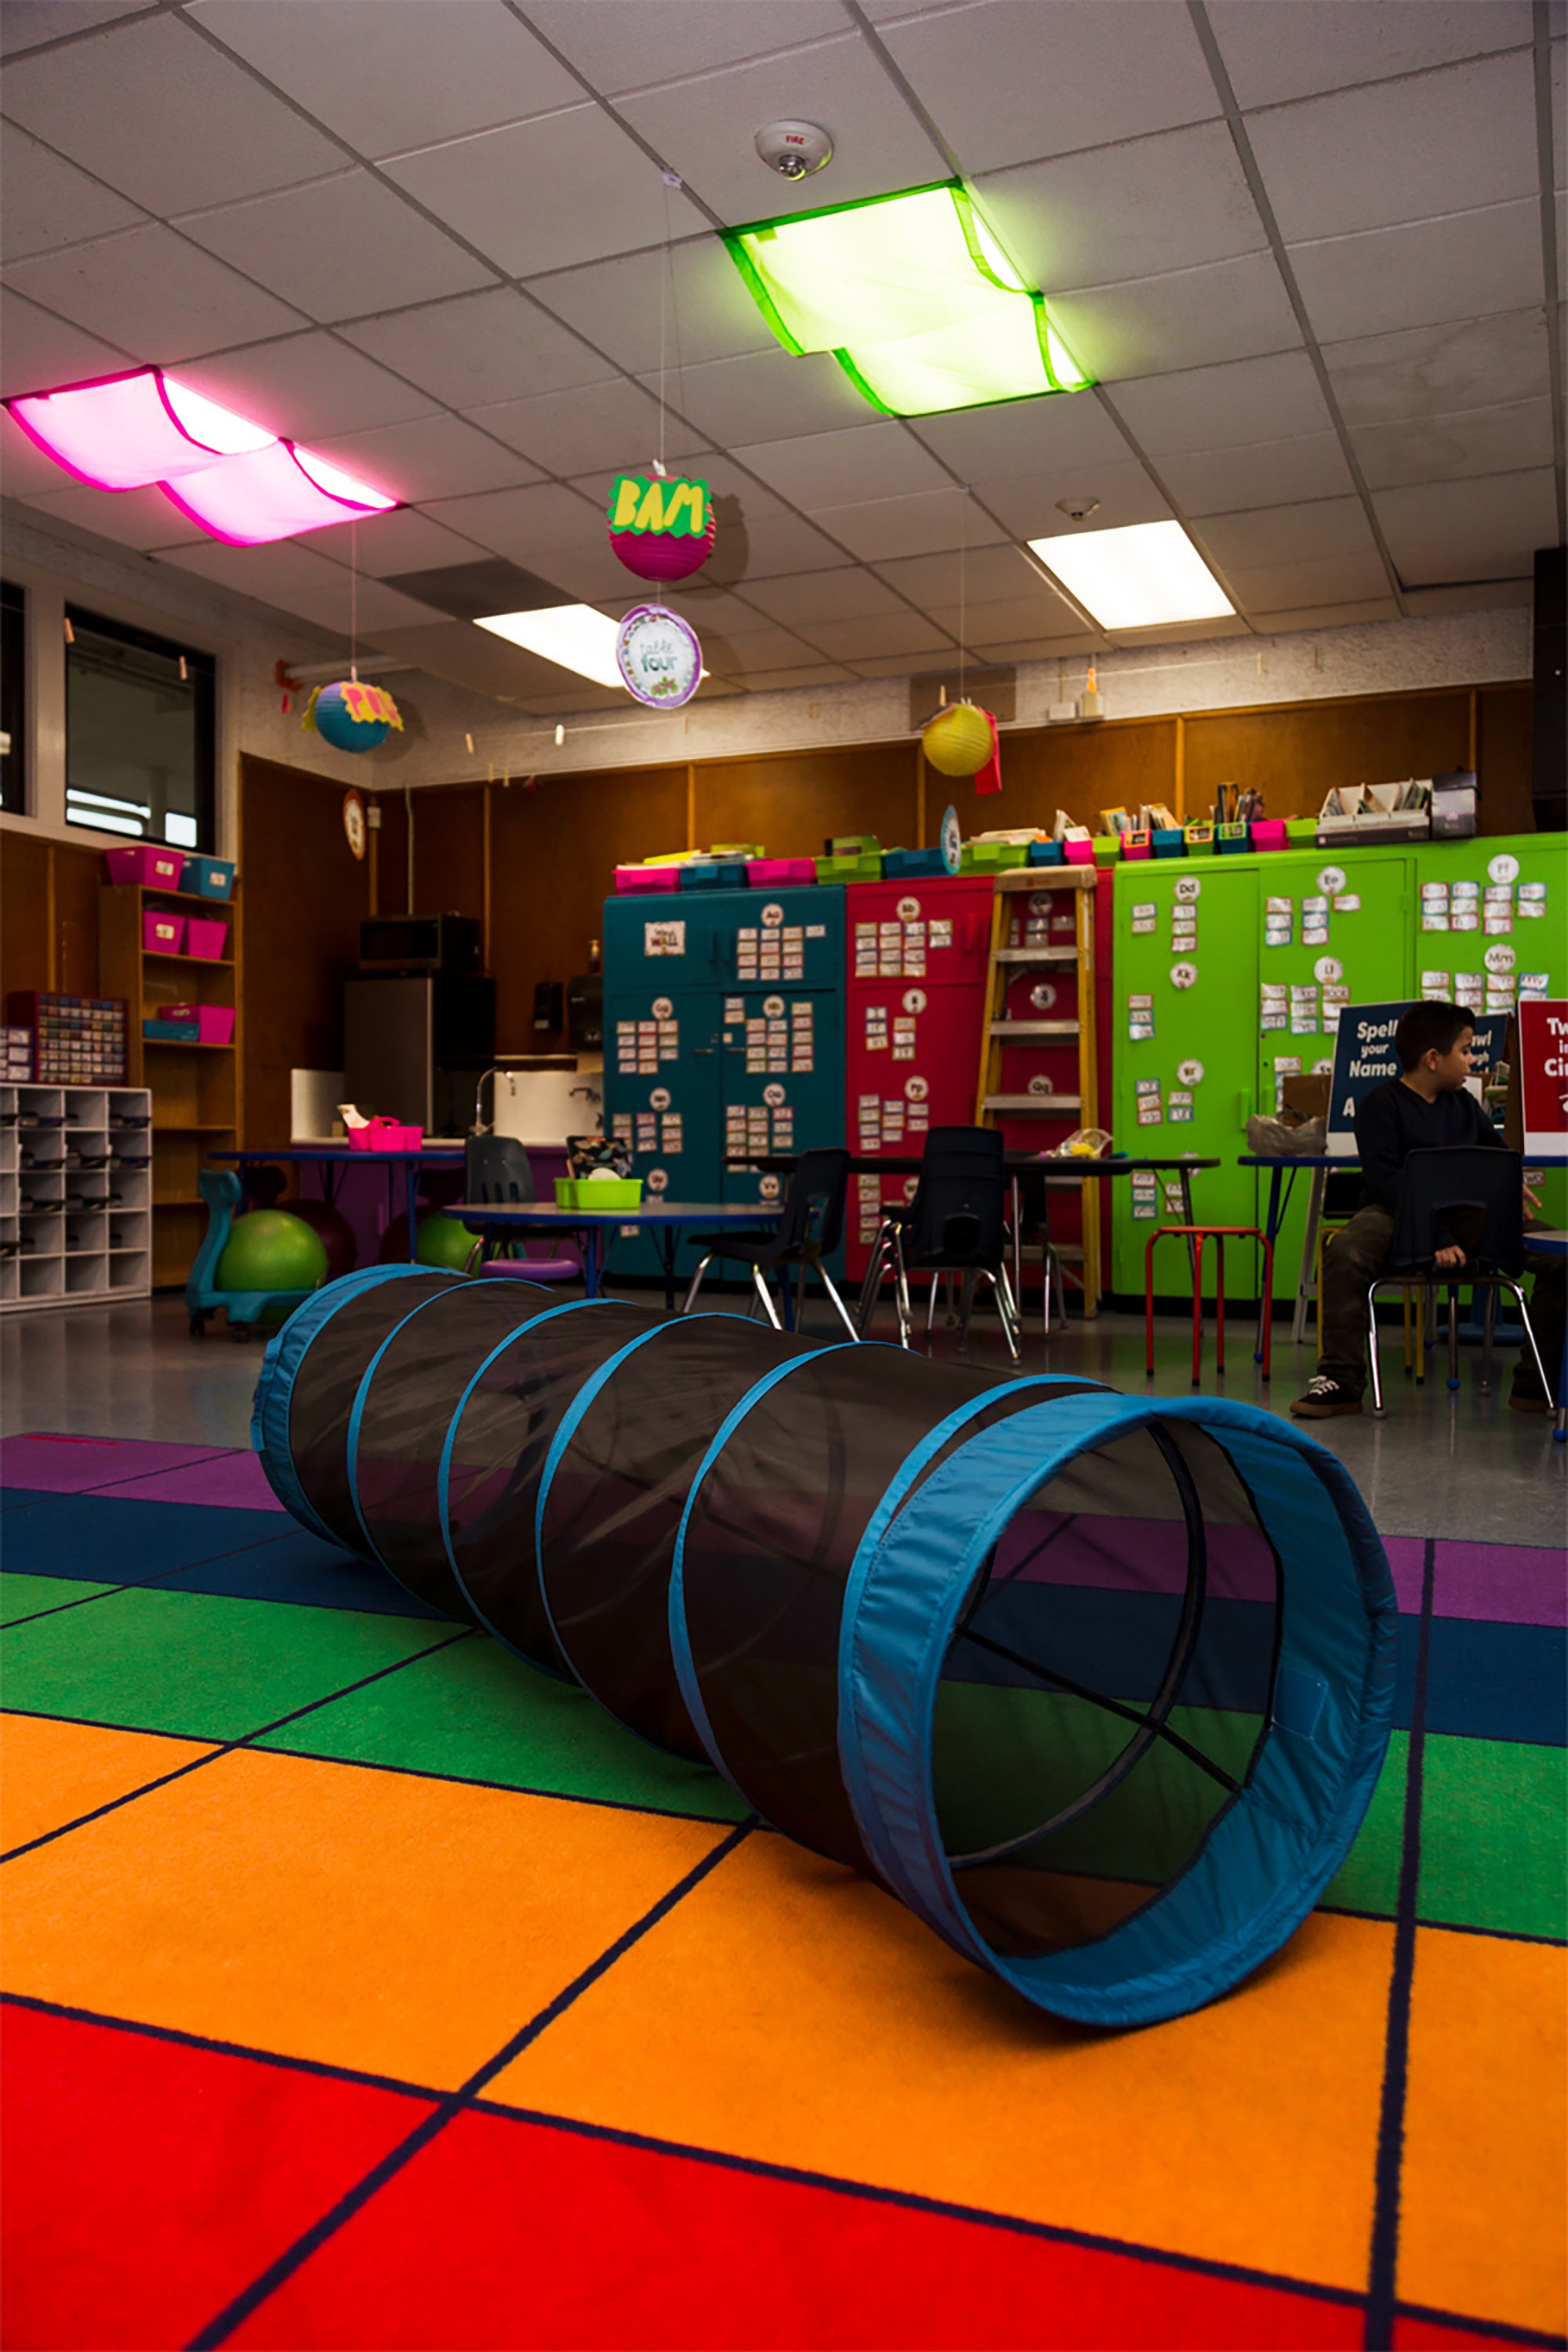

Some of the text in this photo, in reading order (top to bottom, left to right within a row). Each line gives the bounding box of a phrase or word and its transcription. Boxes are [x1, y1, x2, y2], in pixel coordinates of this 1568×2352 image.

[785, 134, 805, 145] FIRE
[614, 479, 704, 533] BAM
[639, 639, 674, 655] table
[641, 654, 677, 672] four
[1497, 863, 1509, 873] Ff
[1323, 876, 1338, 885] Ee
[1180, 884, 1195, 894] Dd
[651, 936, 678, 947] WALL
[1488, 953, 1513, 964] Mm
[1177, 969, 1192, 980] Kk
[1356, 1018, 1399, 1043] Spell
[1360, 1044, 1390, 1059] your
[1348, 1060, 1398, 1078] Name
[911, 1083, 924, 1094] Pp
[1033, 1081, 1049, 1094] Qq
[768, 1090, 782, 1098] Oo
